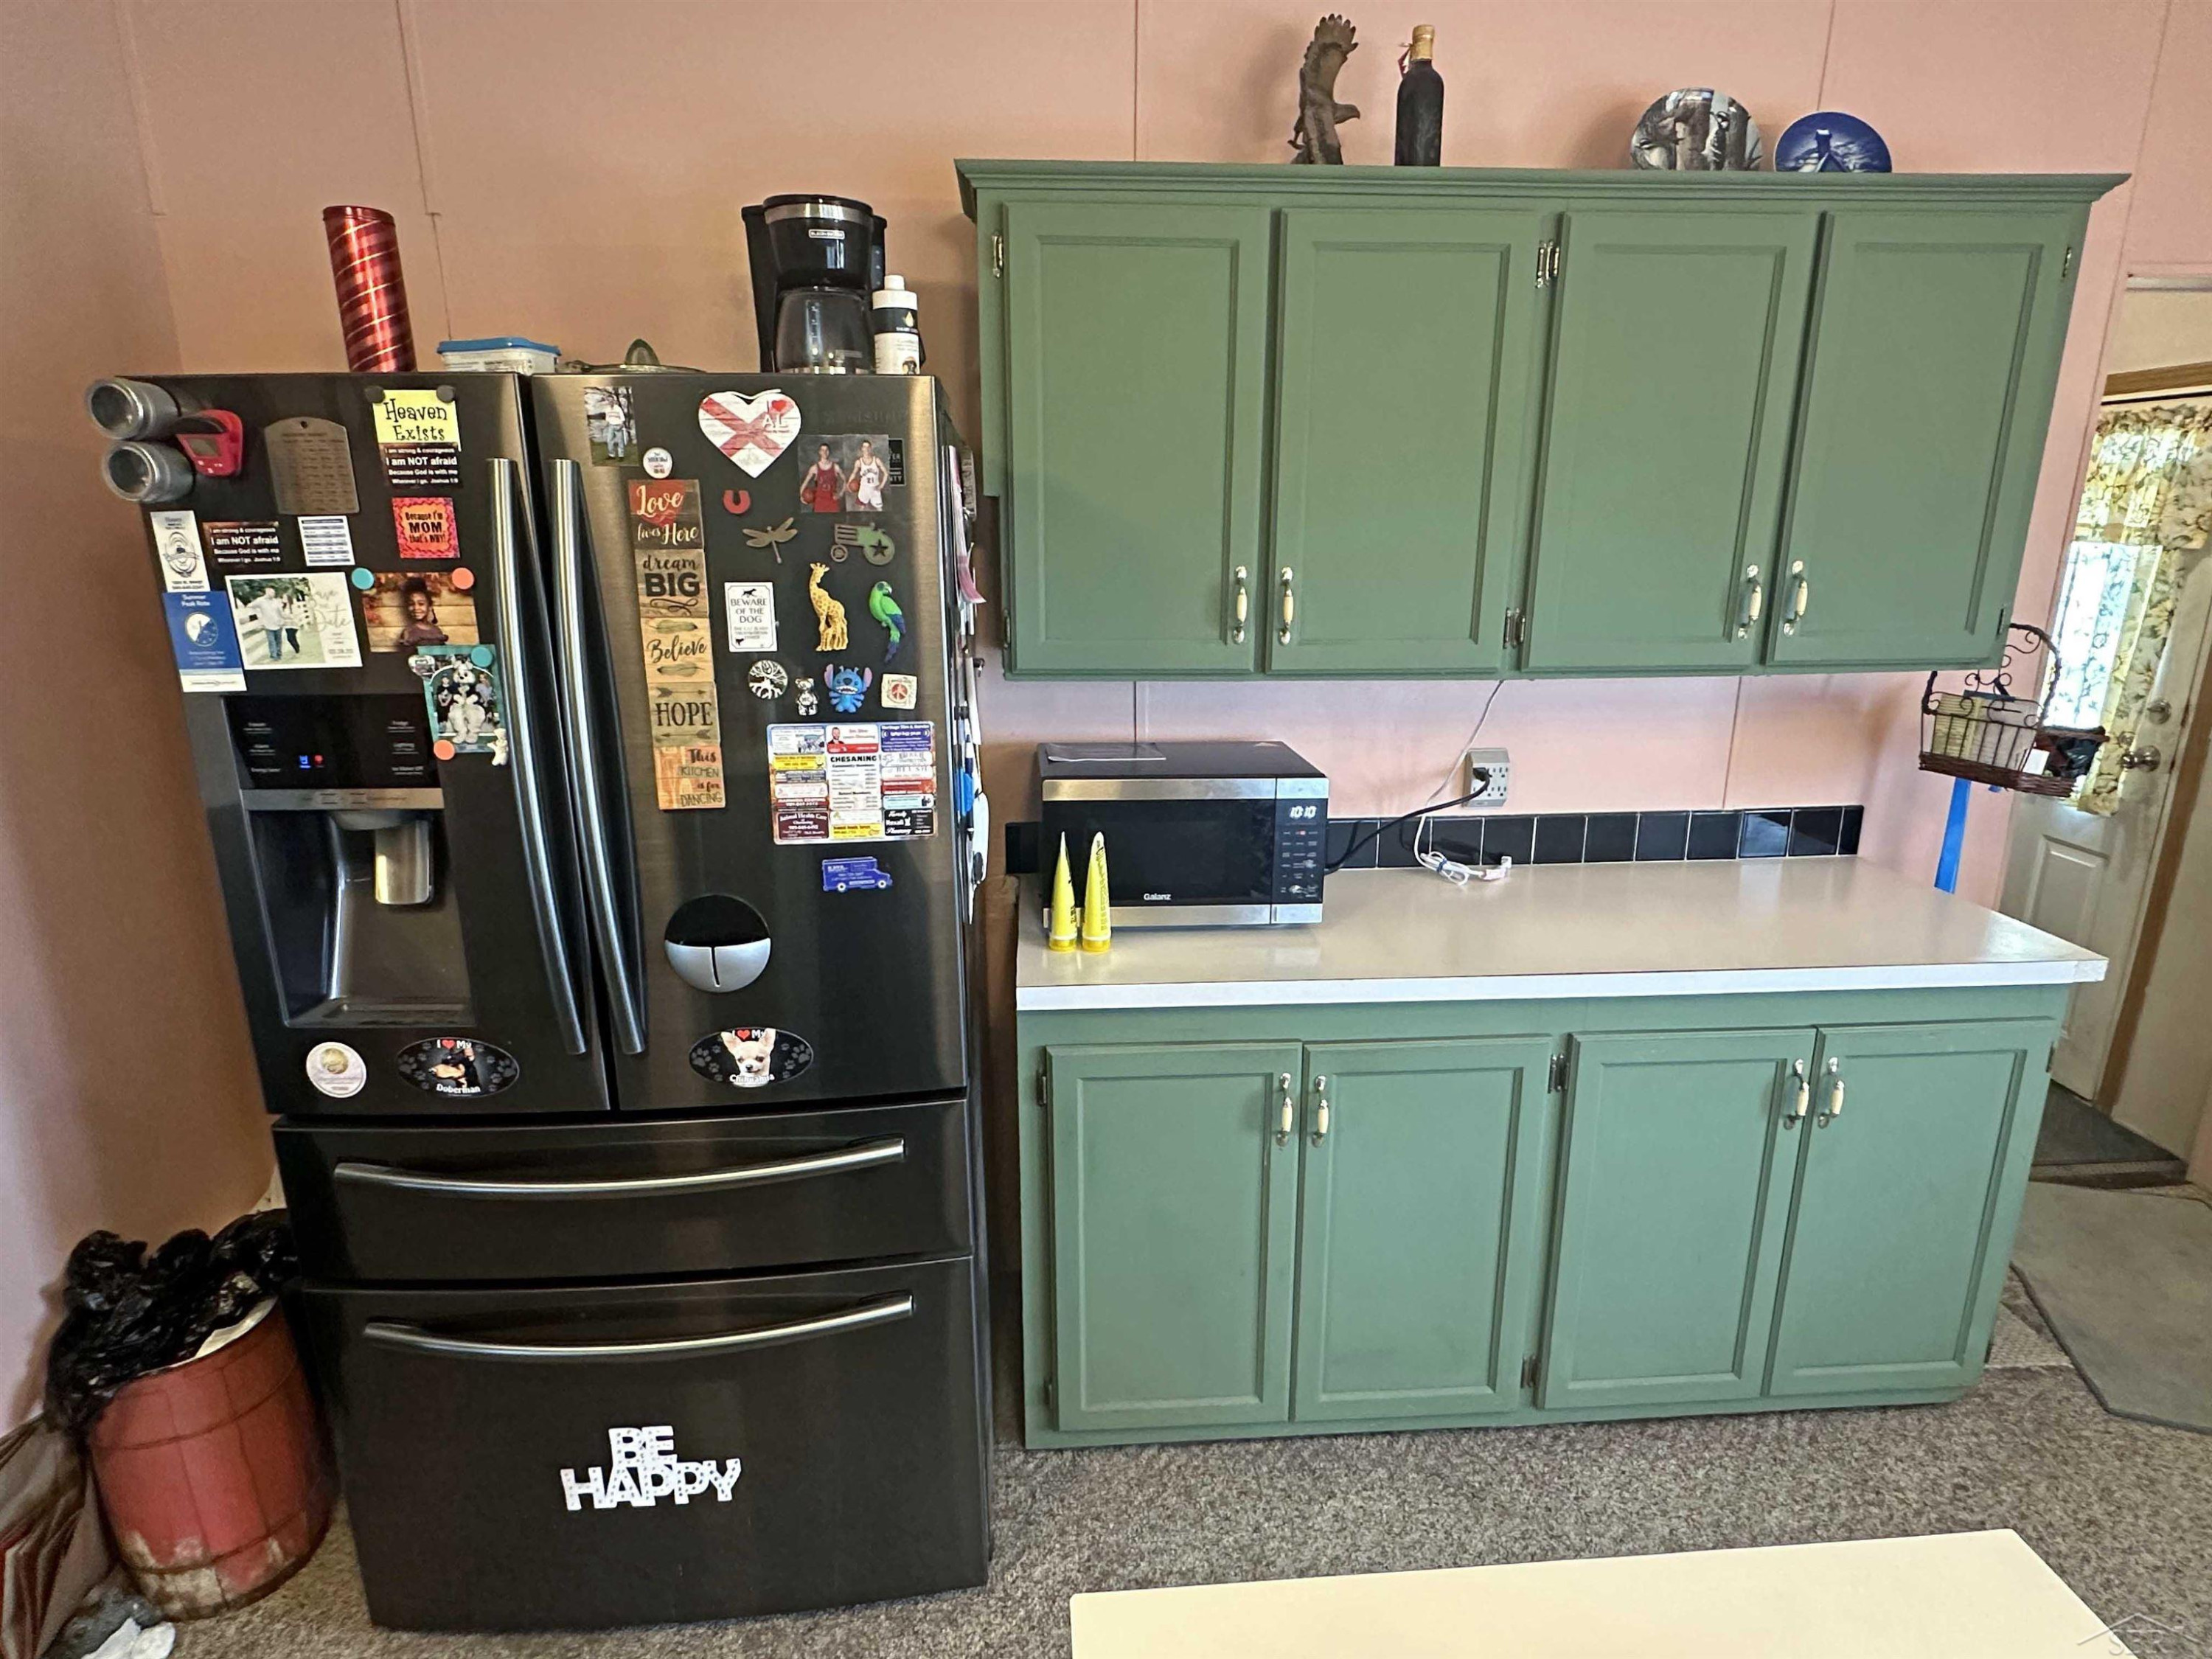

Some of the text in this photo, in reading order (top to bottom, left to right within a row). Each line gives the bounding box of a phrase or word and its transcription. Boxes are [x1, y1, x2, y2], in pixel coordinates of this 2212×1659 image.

[383, 398, 448, 422] Heaven
[392, 425, 445, 441] Exists
[407, 457, 428, 466] NOT
[431, 456, 457, 466] afraid
[636, 485, 684, 518] Love
[408, 521, 442, 533] MOM
[661, 522, 699, 546] Here
[231, 536, 251, 545] NOT
[253, 535, 279, 544] afraid
[643, 554, 698, 571] dream
[644, 572, 700, 597] BIG
[731, 598, 767, 607] BEWARE
[740, 616, 762, 624] DOG
[647, 635, 706, 664] Believe
[655, 702, 713, 726] HOPE
[687, 749, 717, 764] This
[679, 766, 720, 777] KITCHEN
[680, 793, 723, 807] DANCING
[437, 1039, 472, 1049] I My
[437, 1083, 481, 1094] Doberman
[608, 1425, 677, 1467] BE
[560, 1458, 742, 1511] HAPPY
